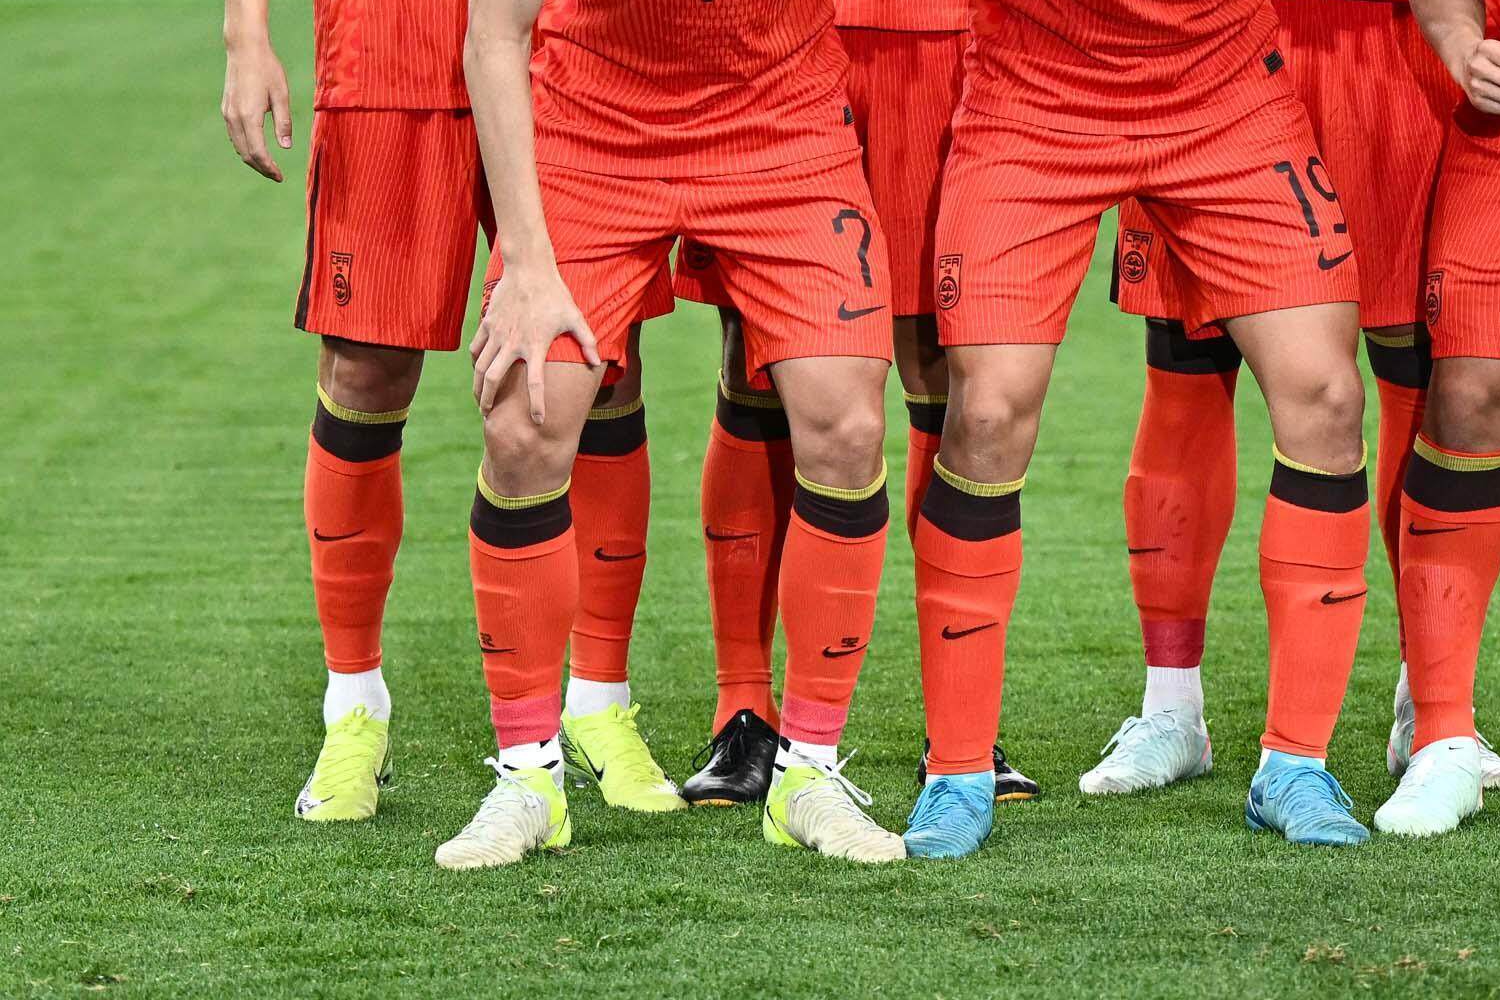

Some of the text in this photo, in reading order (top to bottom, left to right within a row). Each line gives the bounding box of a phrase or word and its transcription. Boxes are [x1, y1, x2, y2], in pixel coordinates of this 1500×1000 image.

[1273, 156, 1347, 237] 19
[832, 209, 873, 289] 7
[1126, 231, 1150, 246] CFA
[940, 257, 959, 269] CFA
